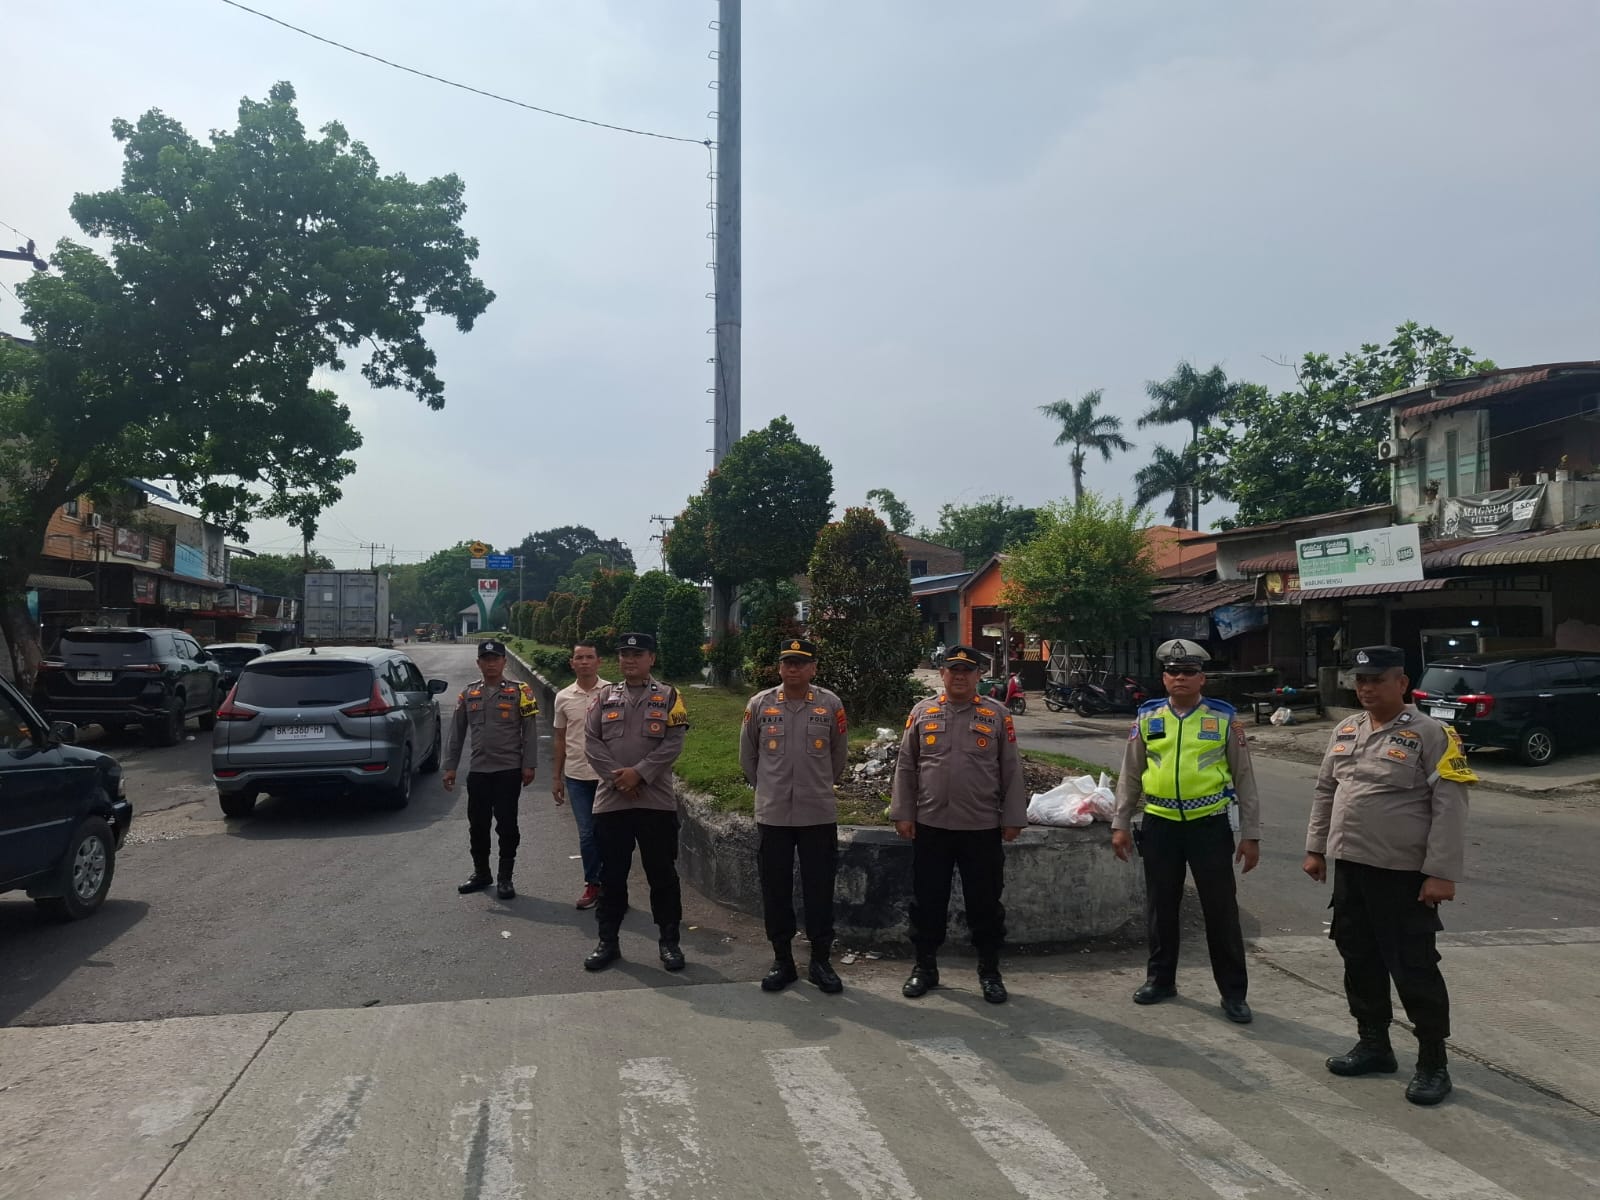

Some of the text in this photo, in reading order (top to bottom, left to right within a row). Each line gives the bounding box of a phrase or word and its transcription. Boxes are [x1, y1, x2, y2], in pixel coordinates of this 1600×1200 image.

[1463, 503, 1510, 517] MAGNUM
[1471, 515, 1499, 524] FILTER
[974, 715, 995, 724] POLRI
[276, 727, 287, 735] BK
[1390, 737, 1418, 750] POLRI
